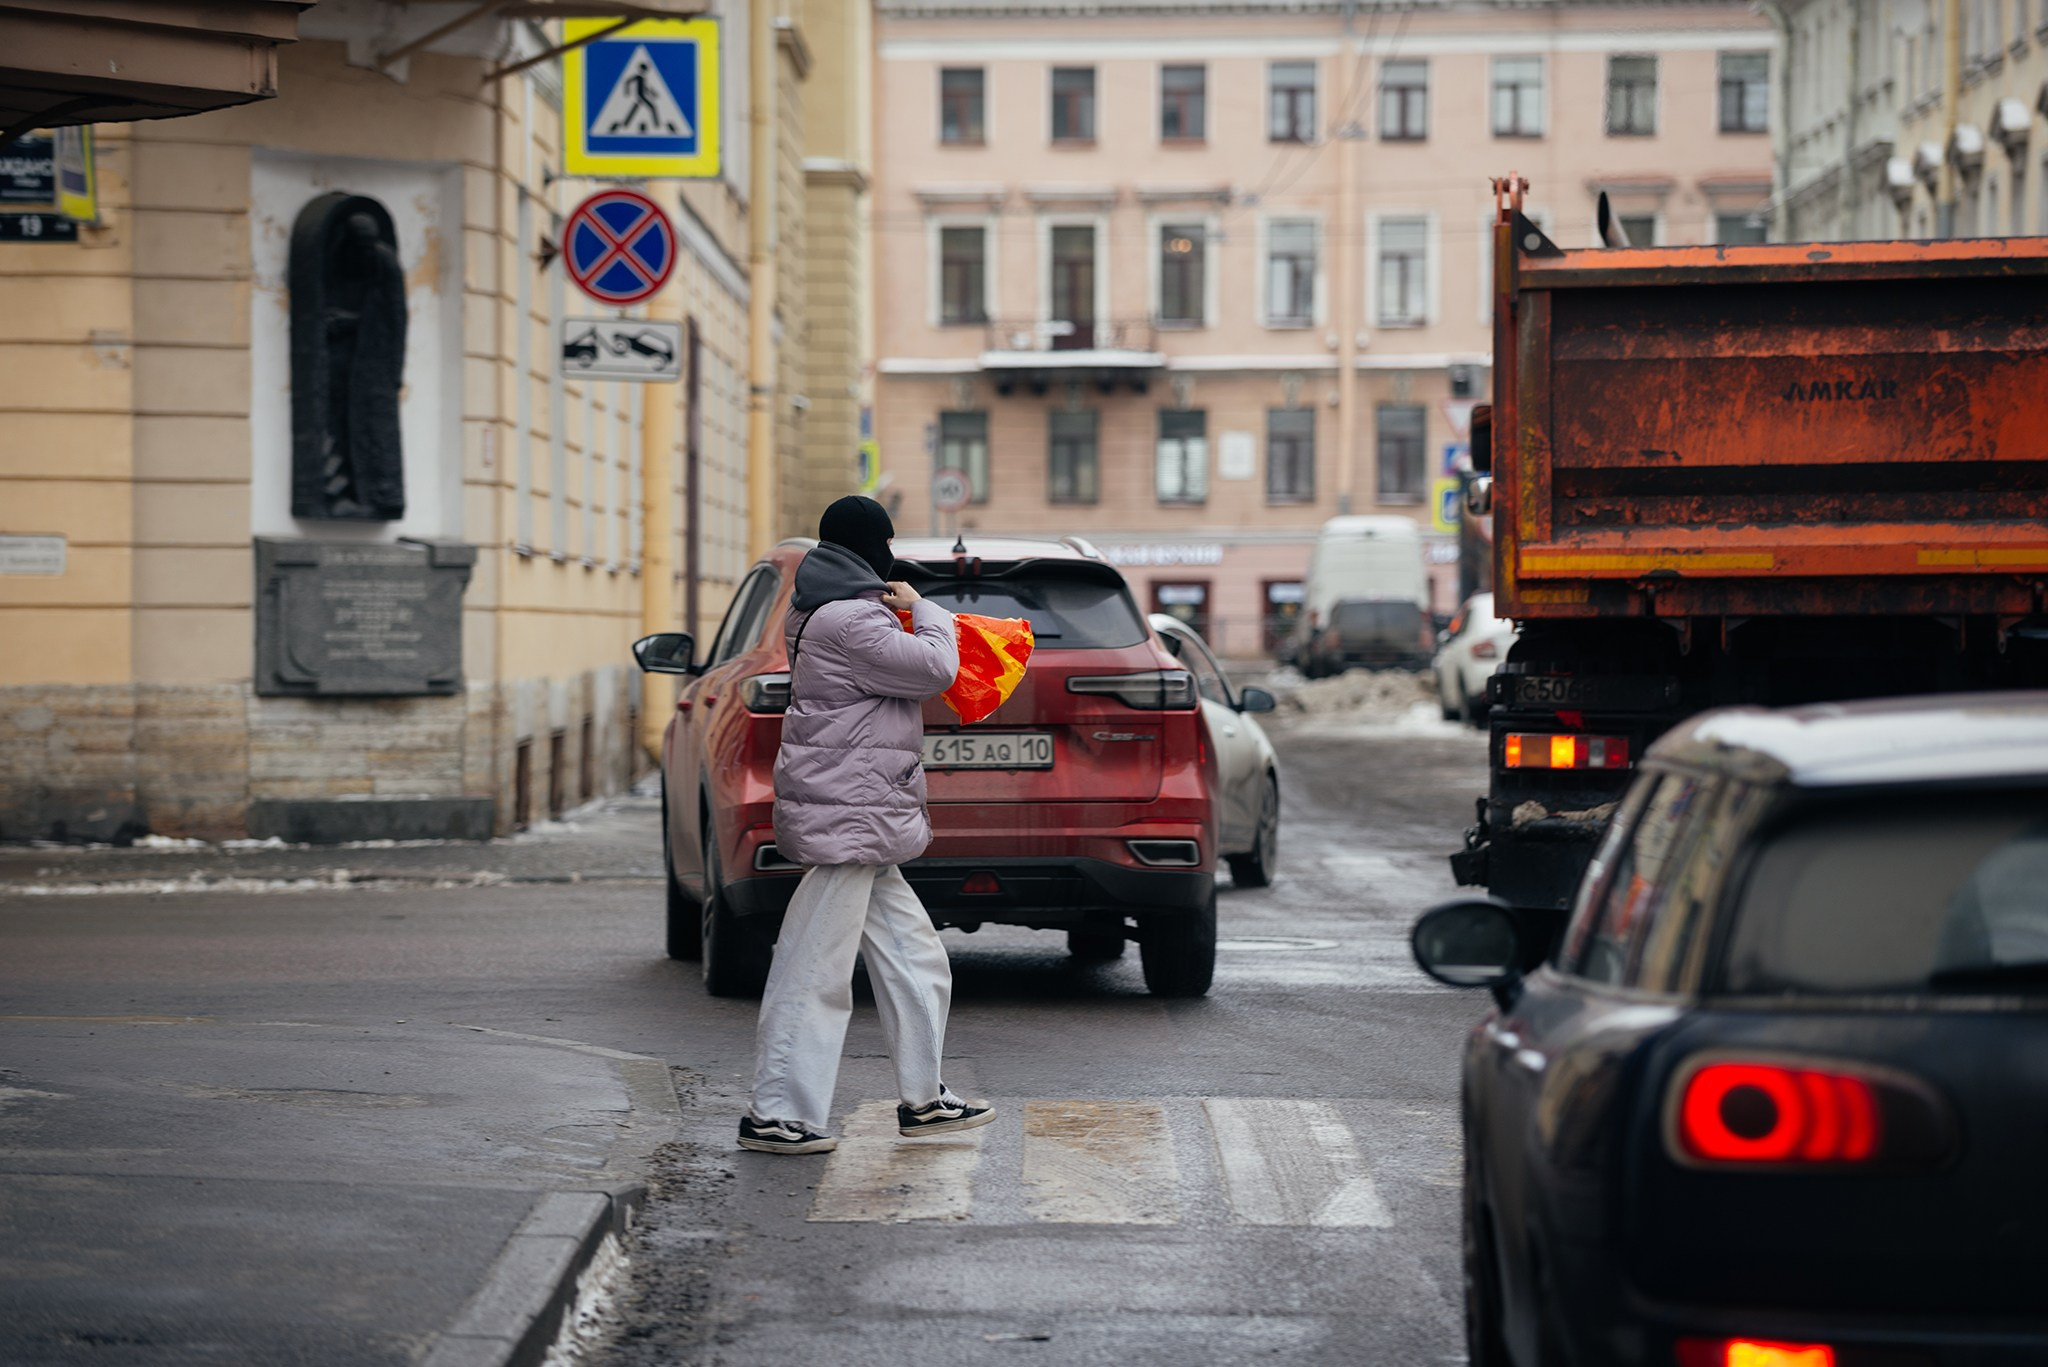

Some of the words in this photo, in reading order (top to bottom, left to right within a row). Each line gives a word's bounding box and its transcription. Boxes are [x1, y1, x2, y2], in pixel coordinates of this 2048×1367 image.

[20, 214, 42, 236] 19
[932, 739, 976, 761] 615
[983, 743, 1011, 761] AQ
[1021, 738, 1050, 761] 10
